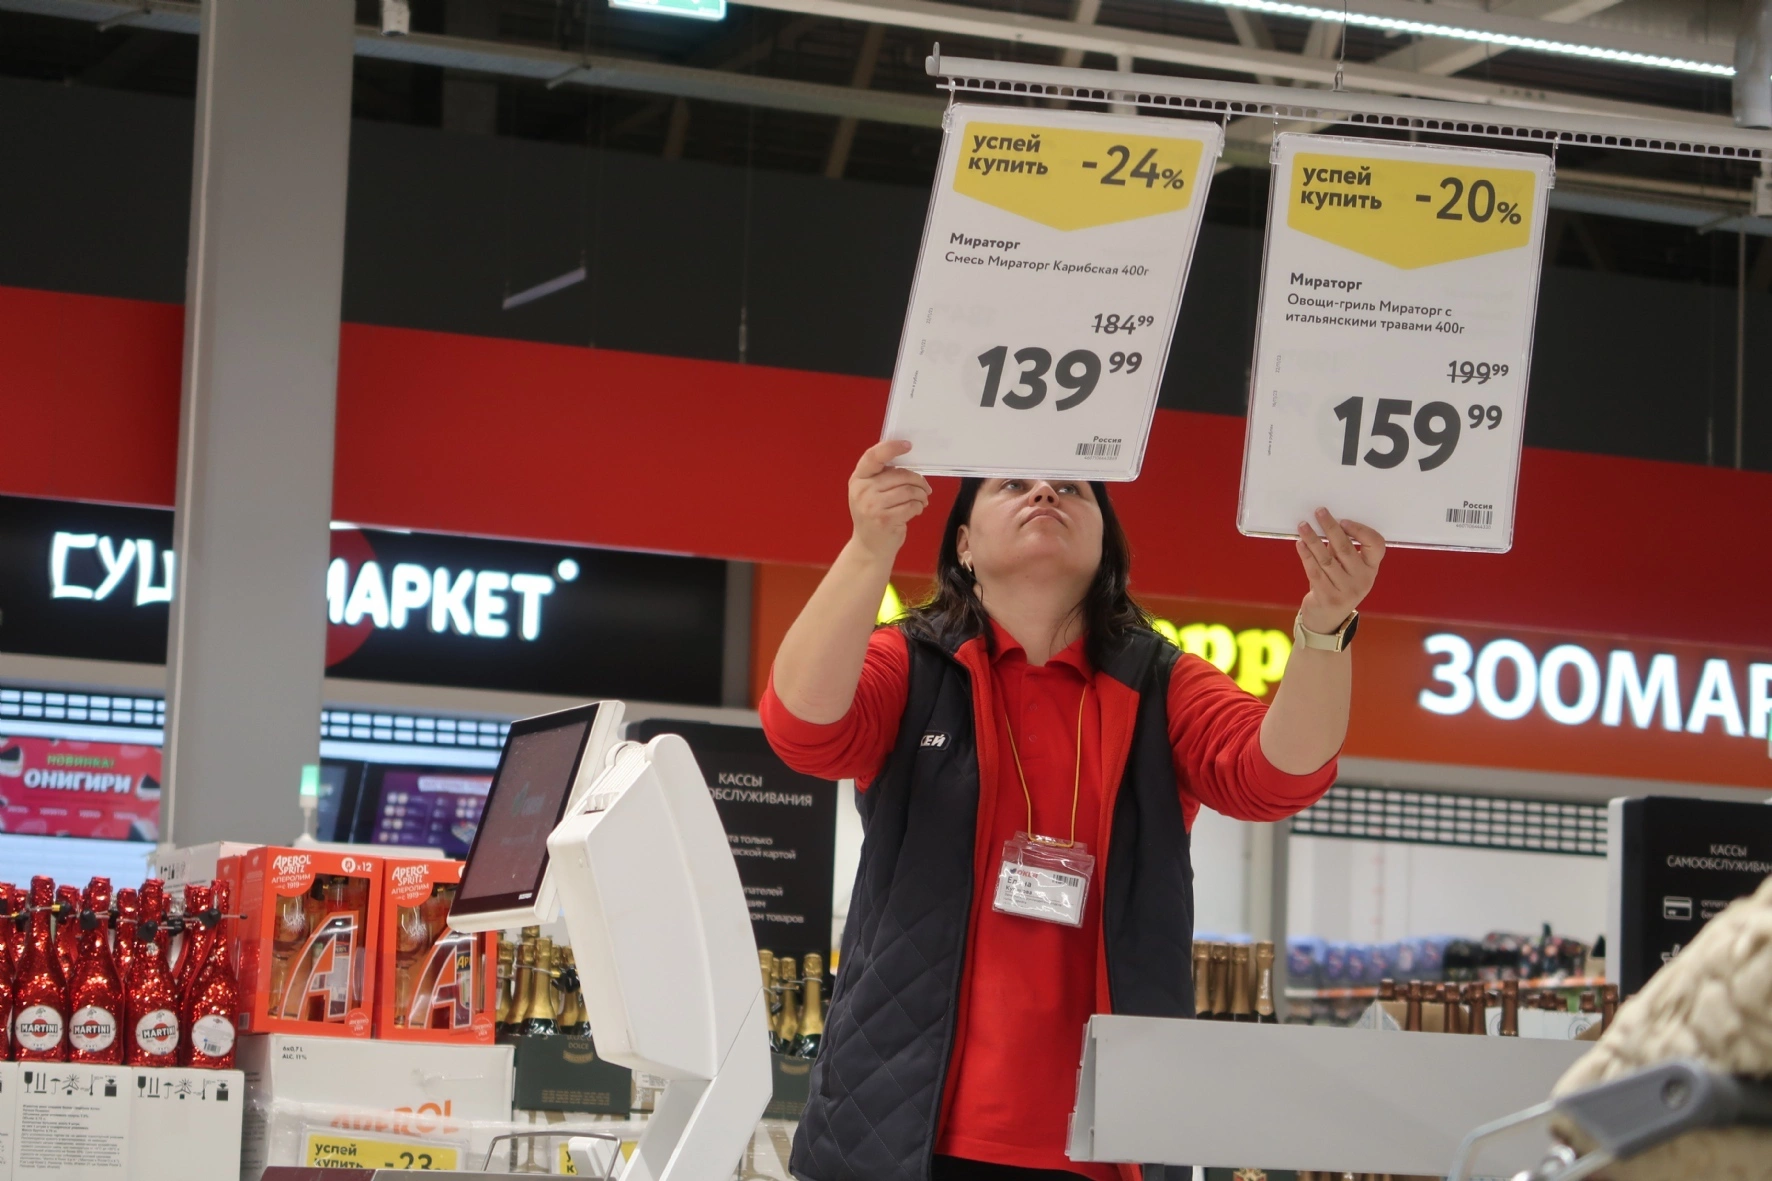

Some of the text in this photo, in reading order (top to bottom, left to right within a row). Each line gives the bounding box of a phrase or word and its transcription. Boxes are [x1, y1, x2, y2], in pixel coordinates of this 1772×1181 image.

[973, 133, 1042, 154] успей
[968, 155, 1049, 176] купить
[1081, 144, 1185, 190] -24%
[1302, 165, 1372, 187] успей
[1300, 189, 1383, 212] купить
[1415, 176, 1522, 226] -20%
[949, 232, 1021, 252] Мираторг
[945, 251, 1149, 278] Смесь Мираторг Карибская 400г
[1290, 272, 1363, 292] Мираторг
[1287, 293, 1452, 319] Овощи-гриль Мираторг с
[1285, 313, 1465, 335] итальянскими травами 400г
[977, 345, 1143, 412] 139 99
[1092, 435, 1122, 443] Россия
[1333, 396, 1503, 472] 159 99
[1463, 500, 1493, 510] Россия
[24, 767, 132, 794] ОНИГИРИ
[718, 773, 763, 787] КАССЫ
[1710, 844, 1747, 857] КАССЫ
[272, 854, 312, 870] APEROL
[278, 864, 305, 876] SPRITZ
[391, 864, 430, 881] APEROL
[21, 1023, 58, 1034] MARTINI
[73, 1025, 111, 1036] MARTINI
[315, 1143, 357, 1156] успей
